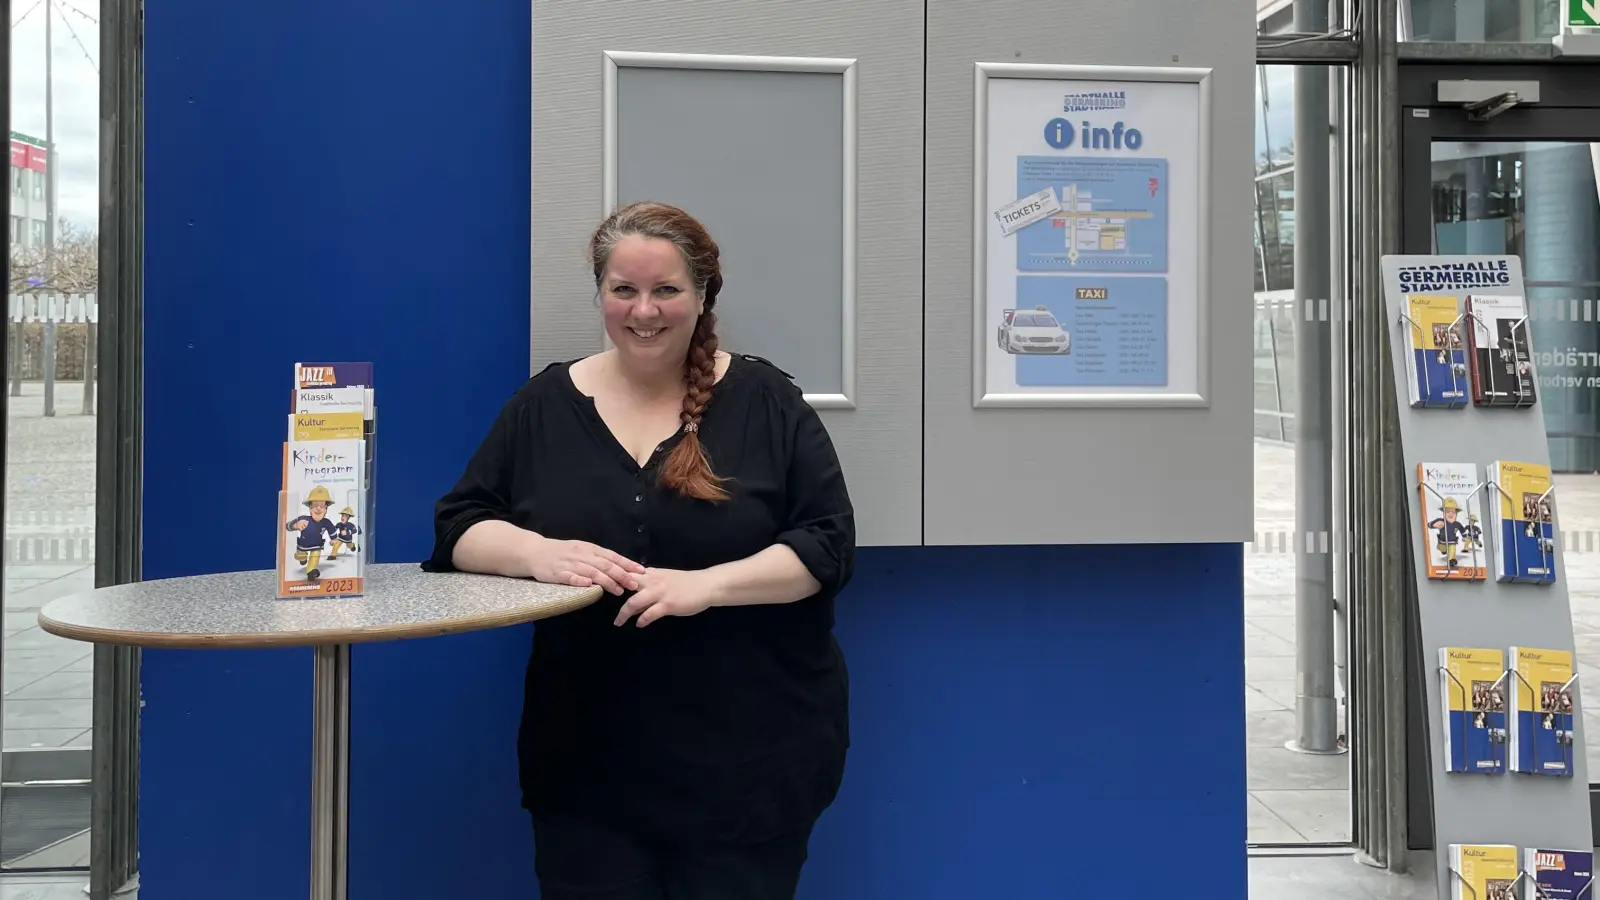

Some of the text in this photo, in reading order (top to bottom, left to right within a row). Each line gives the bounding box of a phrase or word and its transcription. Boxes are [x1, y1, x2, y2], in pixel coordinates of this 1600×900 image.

[1082, 121, 1142, 149] info
[1003, 201, 1041, 223] TICKETS
[1399, 271, 1510, 283] GERMERING
[1078, 289, 1105, 298] TAXI
[1411, 298, 1432, 306] Kultur
[1474, 297, 1499, 305] Klassik
[300, 367, 324, 382] JAZZ
[300, 392, 334, 402] Klassik
[297, 418, 326, 427] Kultur
[293, 447, 346, 467] Kinder-
[304, 465, 354, 478] programm
[1502, 463, 1523, 472] Kultur
[326, 580, 353, 592] 2023
[1520, 652, 1542, 660] Kultur
[1463, 849, 1487, 857] Kultur
[1536, 853, 1556, 867] JAZZ
